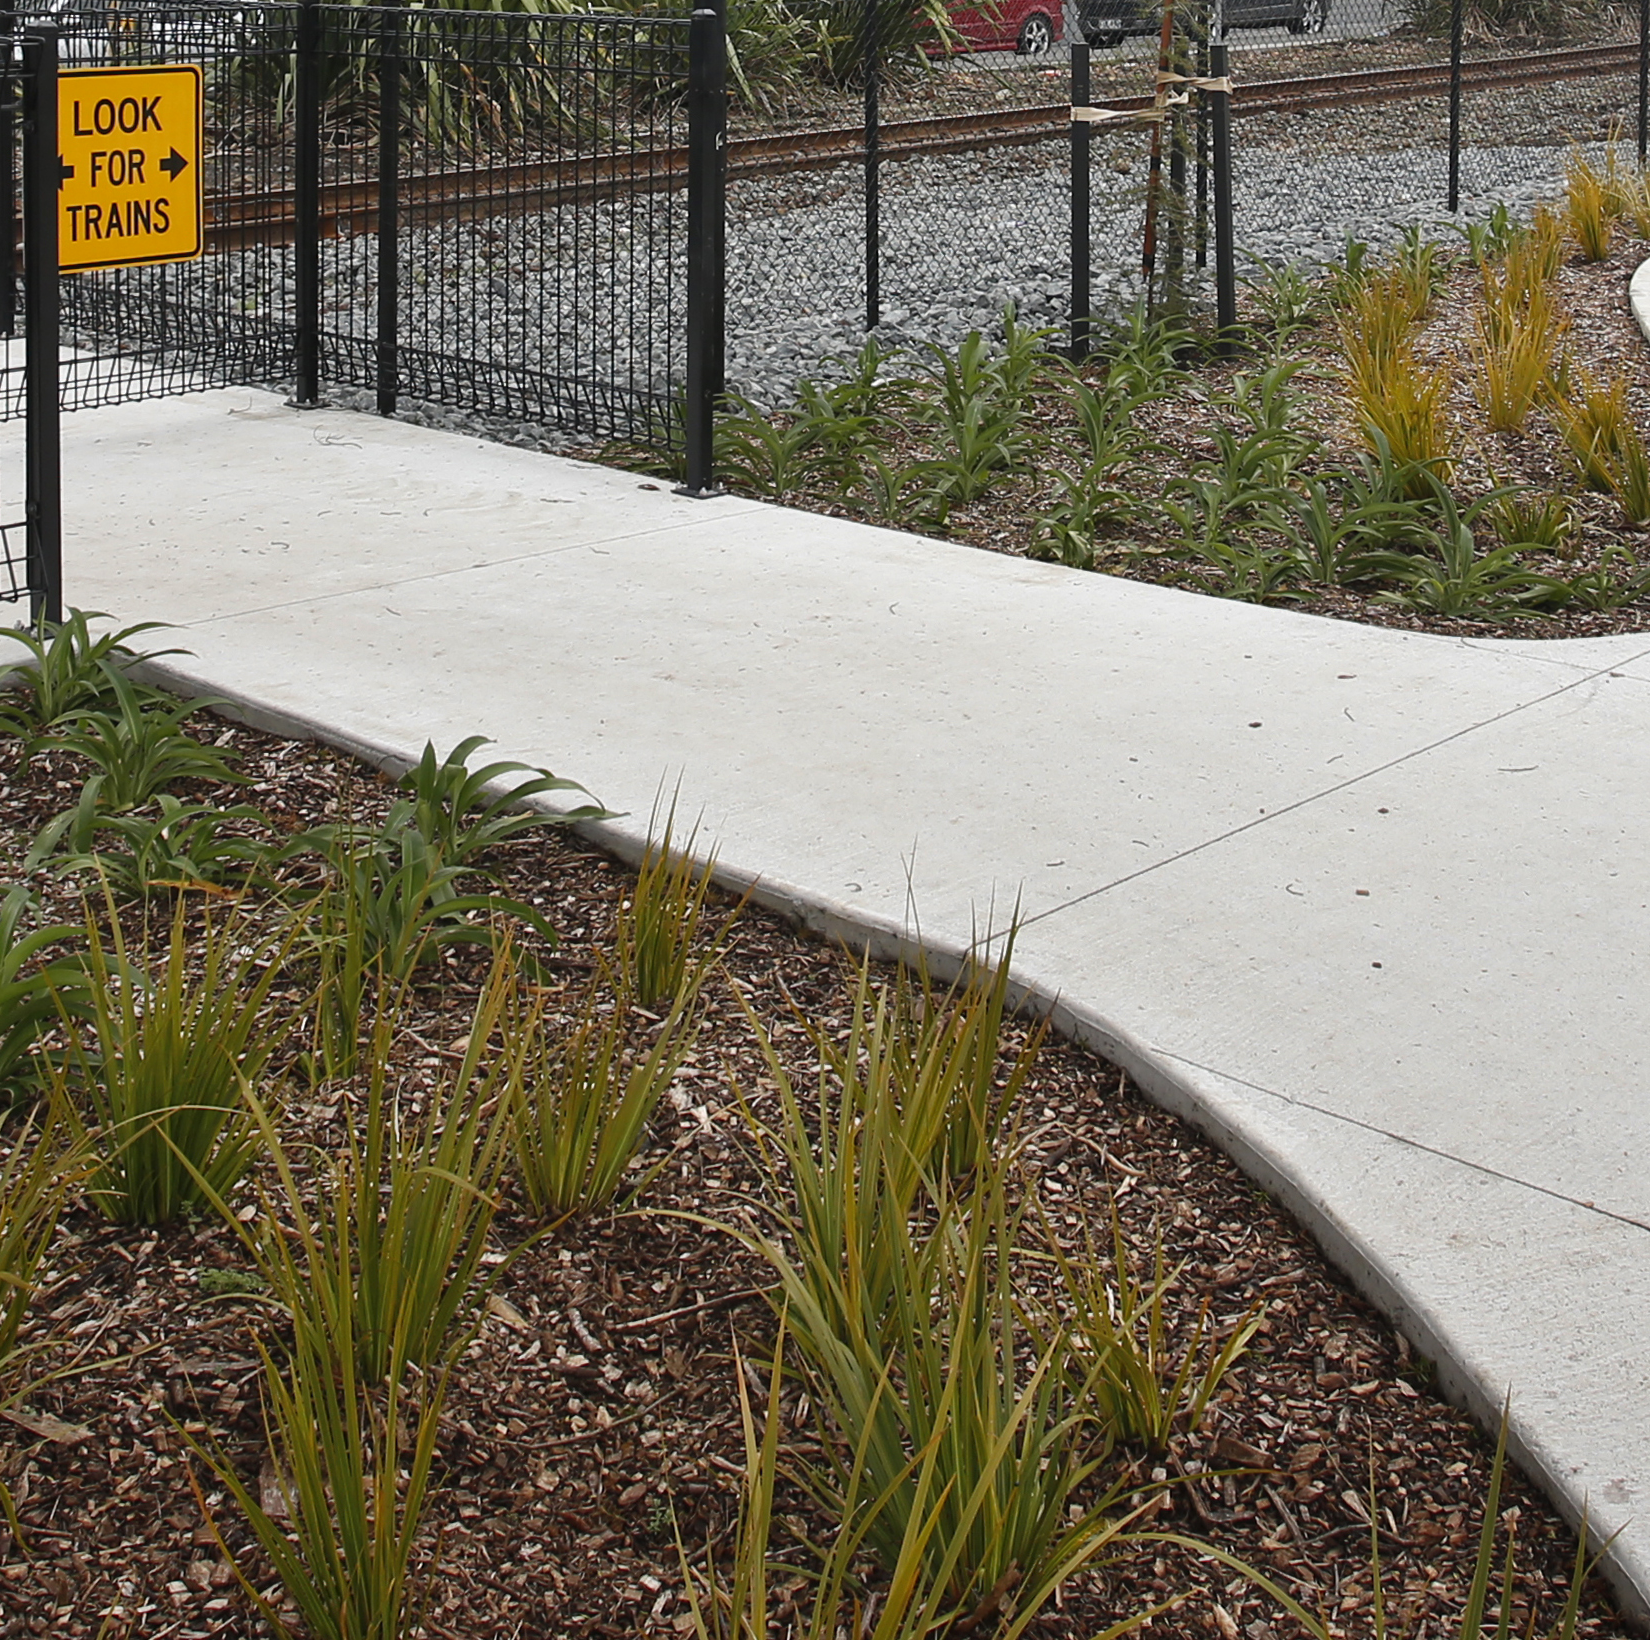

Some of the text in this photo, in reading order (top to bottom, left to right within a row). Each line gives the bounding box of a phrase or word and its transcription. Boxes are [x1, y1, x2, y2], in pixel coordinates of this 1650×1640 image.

[74, 96, 162, 136] LOOK
[91, 149, 145, 187] FOR
[66, 198, 170, 241] TRAINS
